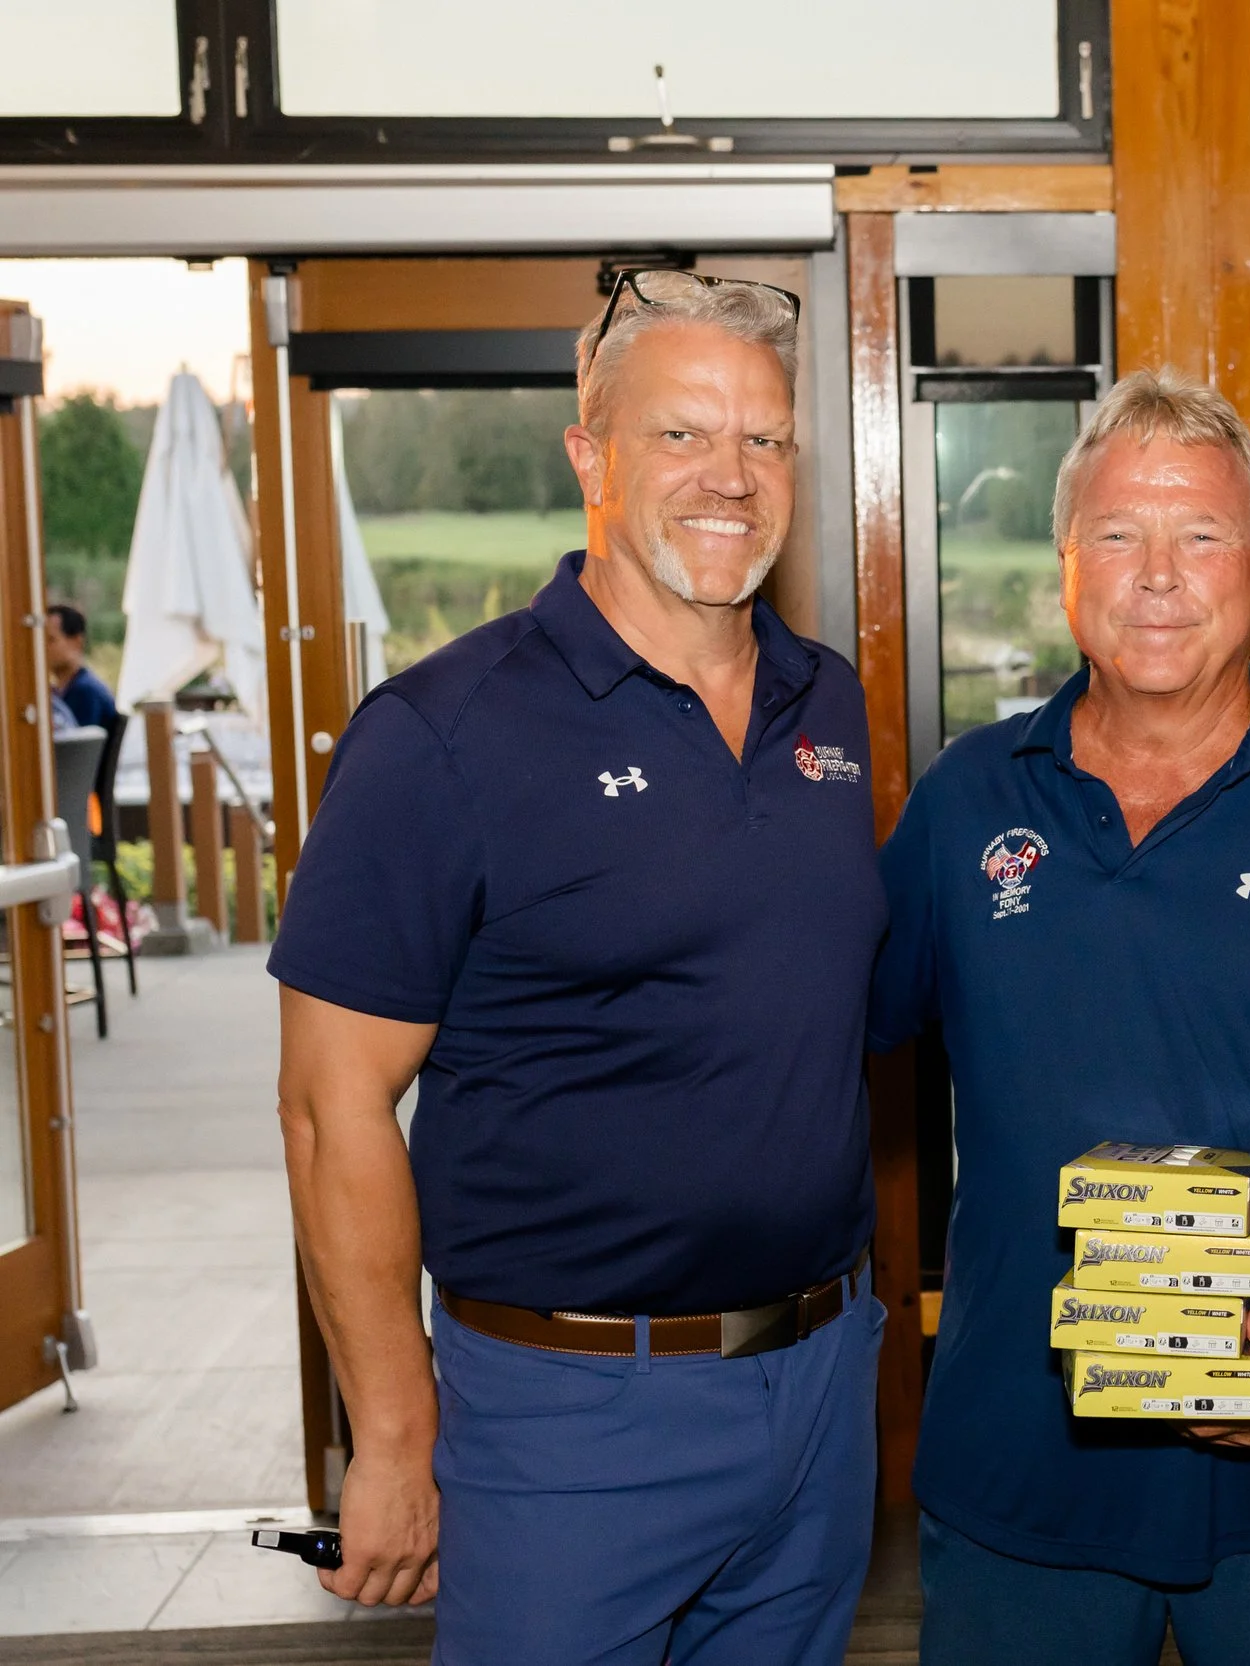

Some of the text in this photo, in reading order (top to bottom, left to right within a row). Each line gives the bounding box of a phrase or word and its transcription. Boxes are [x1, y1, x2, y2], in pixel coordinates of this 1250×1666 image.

[1006, 827, 1049, 857] FIREFIGHTERS
[999, 896, 1022, 910] FDNY
[1000, 885, 1031, 900] MEMORY
[1062, 1176, 1154, 1208] SRIXON
[1078, 1238, 1170, 1271] SRIXON
[1055, 1297, 1146, 1330] SRIXON
[1079, 1364, 1171, 1397] SRIXON
